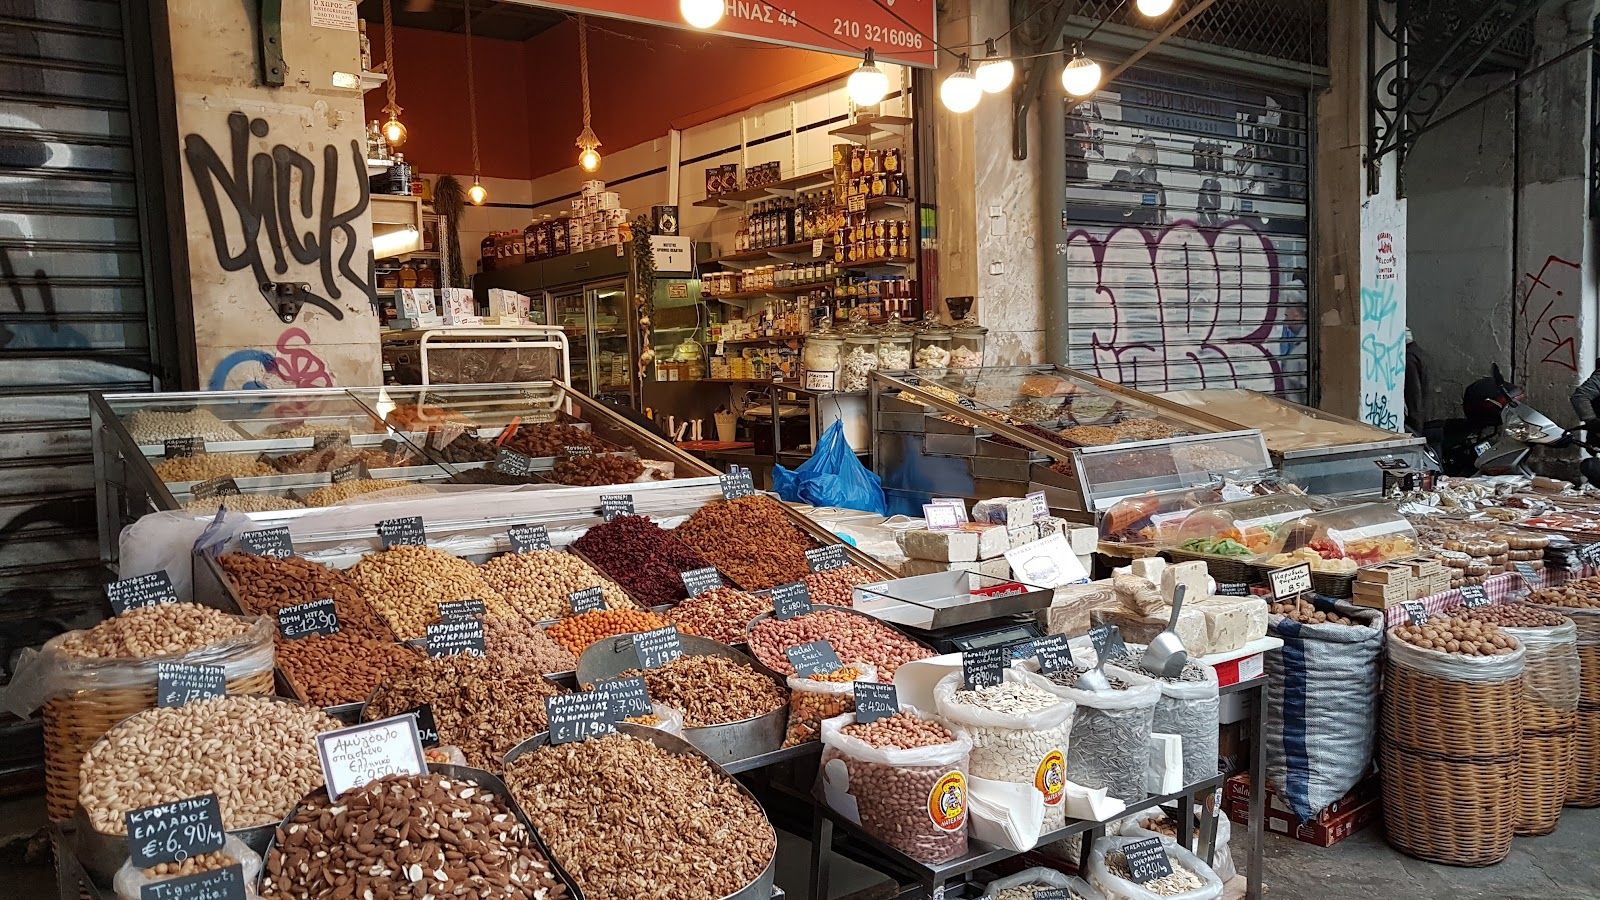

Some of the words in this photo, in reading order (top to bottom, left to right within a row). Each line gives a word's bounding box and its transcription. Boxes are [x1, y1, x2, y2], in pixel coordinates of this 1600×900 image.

[778, 8, 798, 28] 44
[833, 18, 860, 38] 210
[864, 23, 922, 50] 3216096
[279, 598, 335, 615] ΑΜΥΓΔΑΛΟΨΙΧΑ
[280, 615, 301, 625] ΩΜΗ
[427, 621, 479, 636] ΚΑΡΥΔΟΨΙΧΑ
[548, 691, 610, 709] ΚΑΡΥΔΟΨΙΧΑ
[610, 688, 645, 700] ΠΑΝΙΑΣ
[555, 701, 608, 715] ΟΥΚΡΑΝΙΑΣ
[134, 810, 210, 839] ΕΛΛΑΔΟΣ
[149, 881, 197, 899] Tiger
